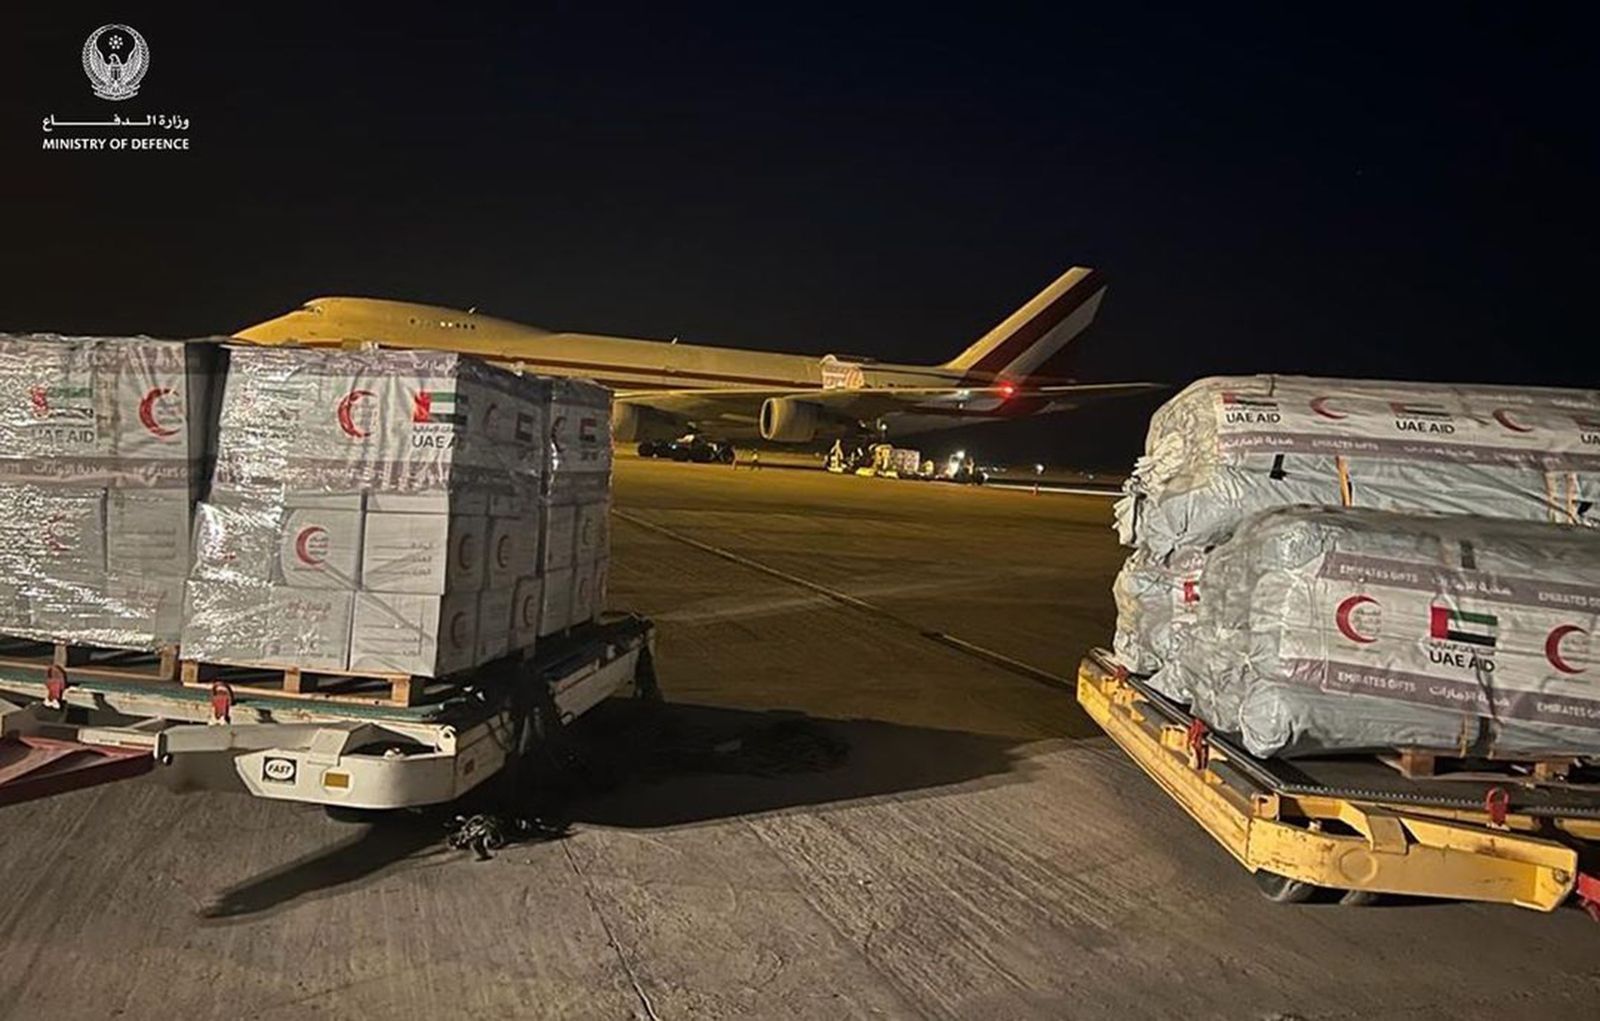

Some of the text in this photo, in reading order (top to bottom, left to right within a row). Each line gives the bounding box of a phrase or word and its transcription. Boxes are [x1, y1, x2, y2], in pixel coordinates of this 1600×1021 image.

[1226, 412, 1281, 424] UAE AID
[1395, 420, 1456, 435] UAE AID
[66, 429, 95, 444] AID
[412, 434, 446, 449] UAE
[1430, 650, 1496, 673] UAE AID
[1536, 702, 1586, 718] EMIRATES
[267, 763, 292, 776] FAST
